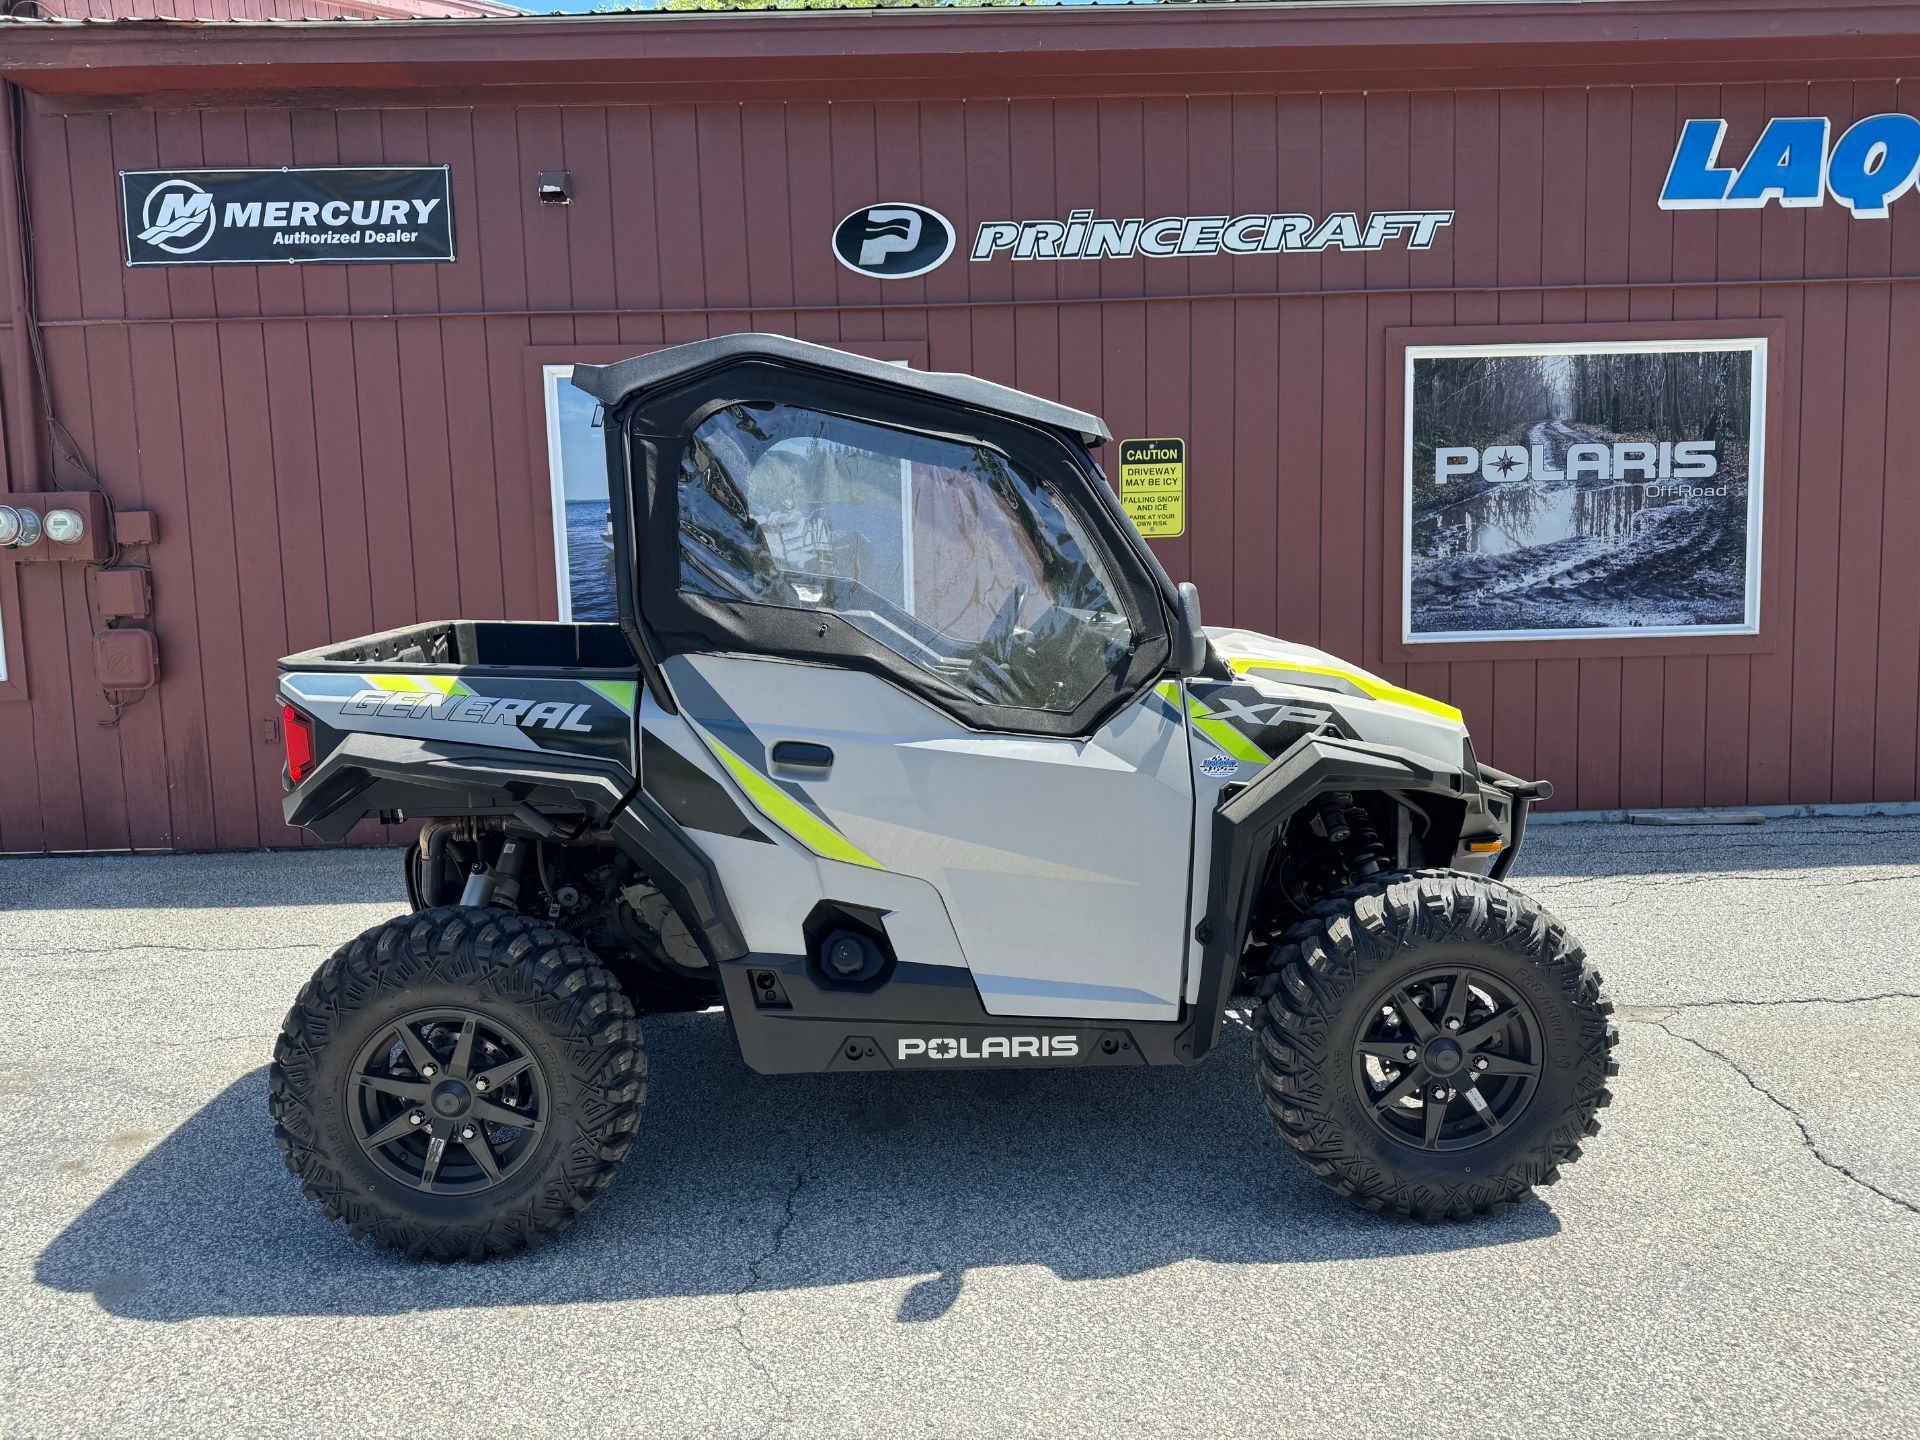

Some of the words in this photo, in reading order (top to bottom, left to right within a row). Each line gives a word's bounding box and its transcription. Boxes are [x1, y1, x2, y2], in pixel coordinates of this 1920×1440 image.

[1657, 113, 1920, 220] LAQ
[223, 198, 441, 228] MERCURY
[273, 230, 361, 246] Authorized
[364, 229, 419, 245] Dealer
[969, 209, 1456, 262] PRINCECRAFT
[1126, 449, 1178, 461] CAUTION
[1434, 440, 1718, 485] POLARIS
[1125, 478, 1146, 487] MAY
[1148, 478, 1160, 486] BE
[1163, 477, 1178, 486] ICY
[1127, 467, 1177, 476] DRIVEWAY
[1157, 495, 1180, 503] SNOW
[1645, 484, 1727, 498] Off-Road
[339, 688, 593, 733] GENERAL
[1192, 698, 1333, 727] XP
[898, 1035, 1080, 1061] POLARIS
